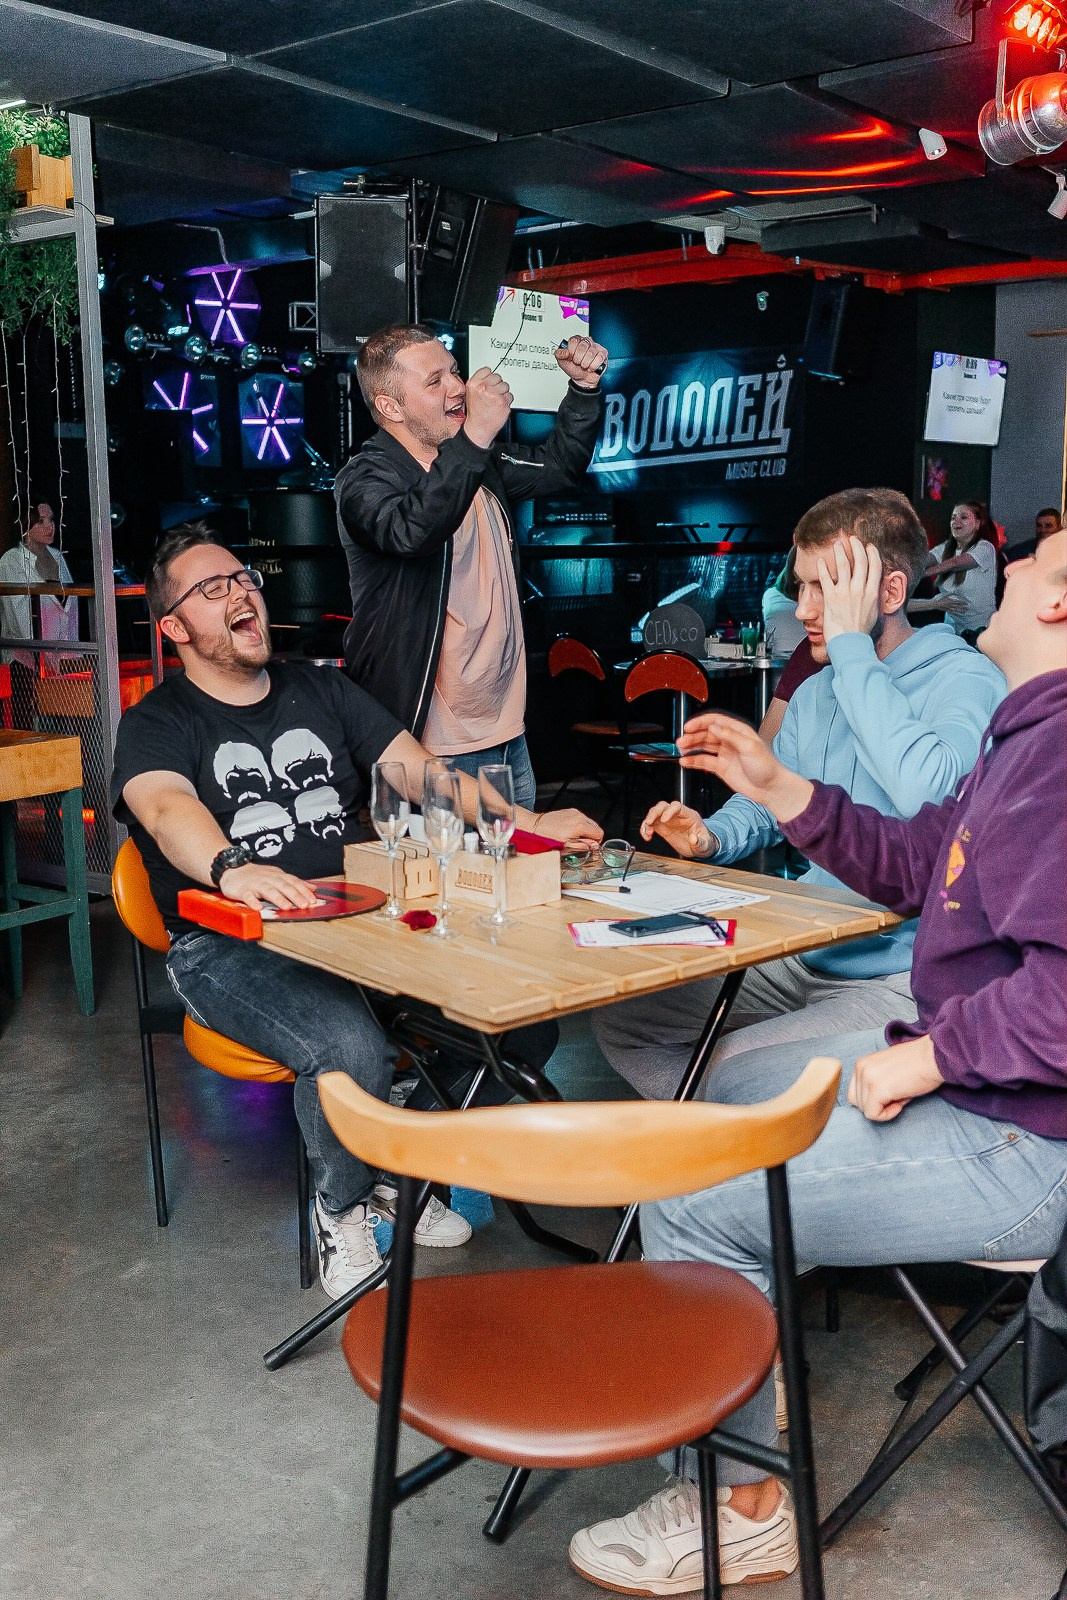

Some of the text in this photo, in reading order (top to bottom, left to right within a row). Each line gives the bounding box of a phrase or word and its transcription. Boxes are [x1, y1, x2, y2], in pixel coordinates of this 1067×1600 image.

[515, 343, 528, 353] три
[529, 345, 550, 355] слова
[500, 357, 560, 371] пропеты дальше
[598, 354, 794, 458] ВОДОЛЕЙ
[725, 458, 787, 480] MUSIC CLUB
